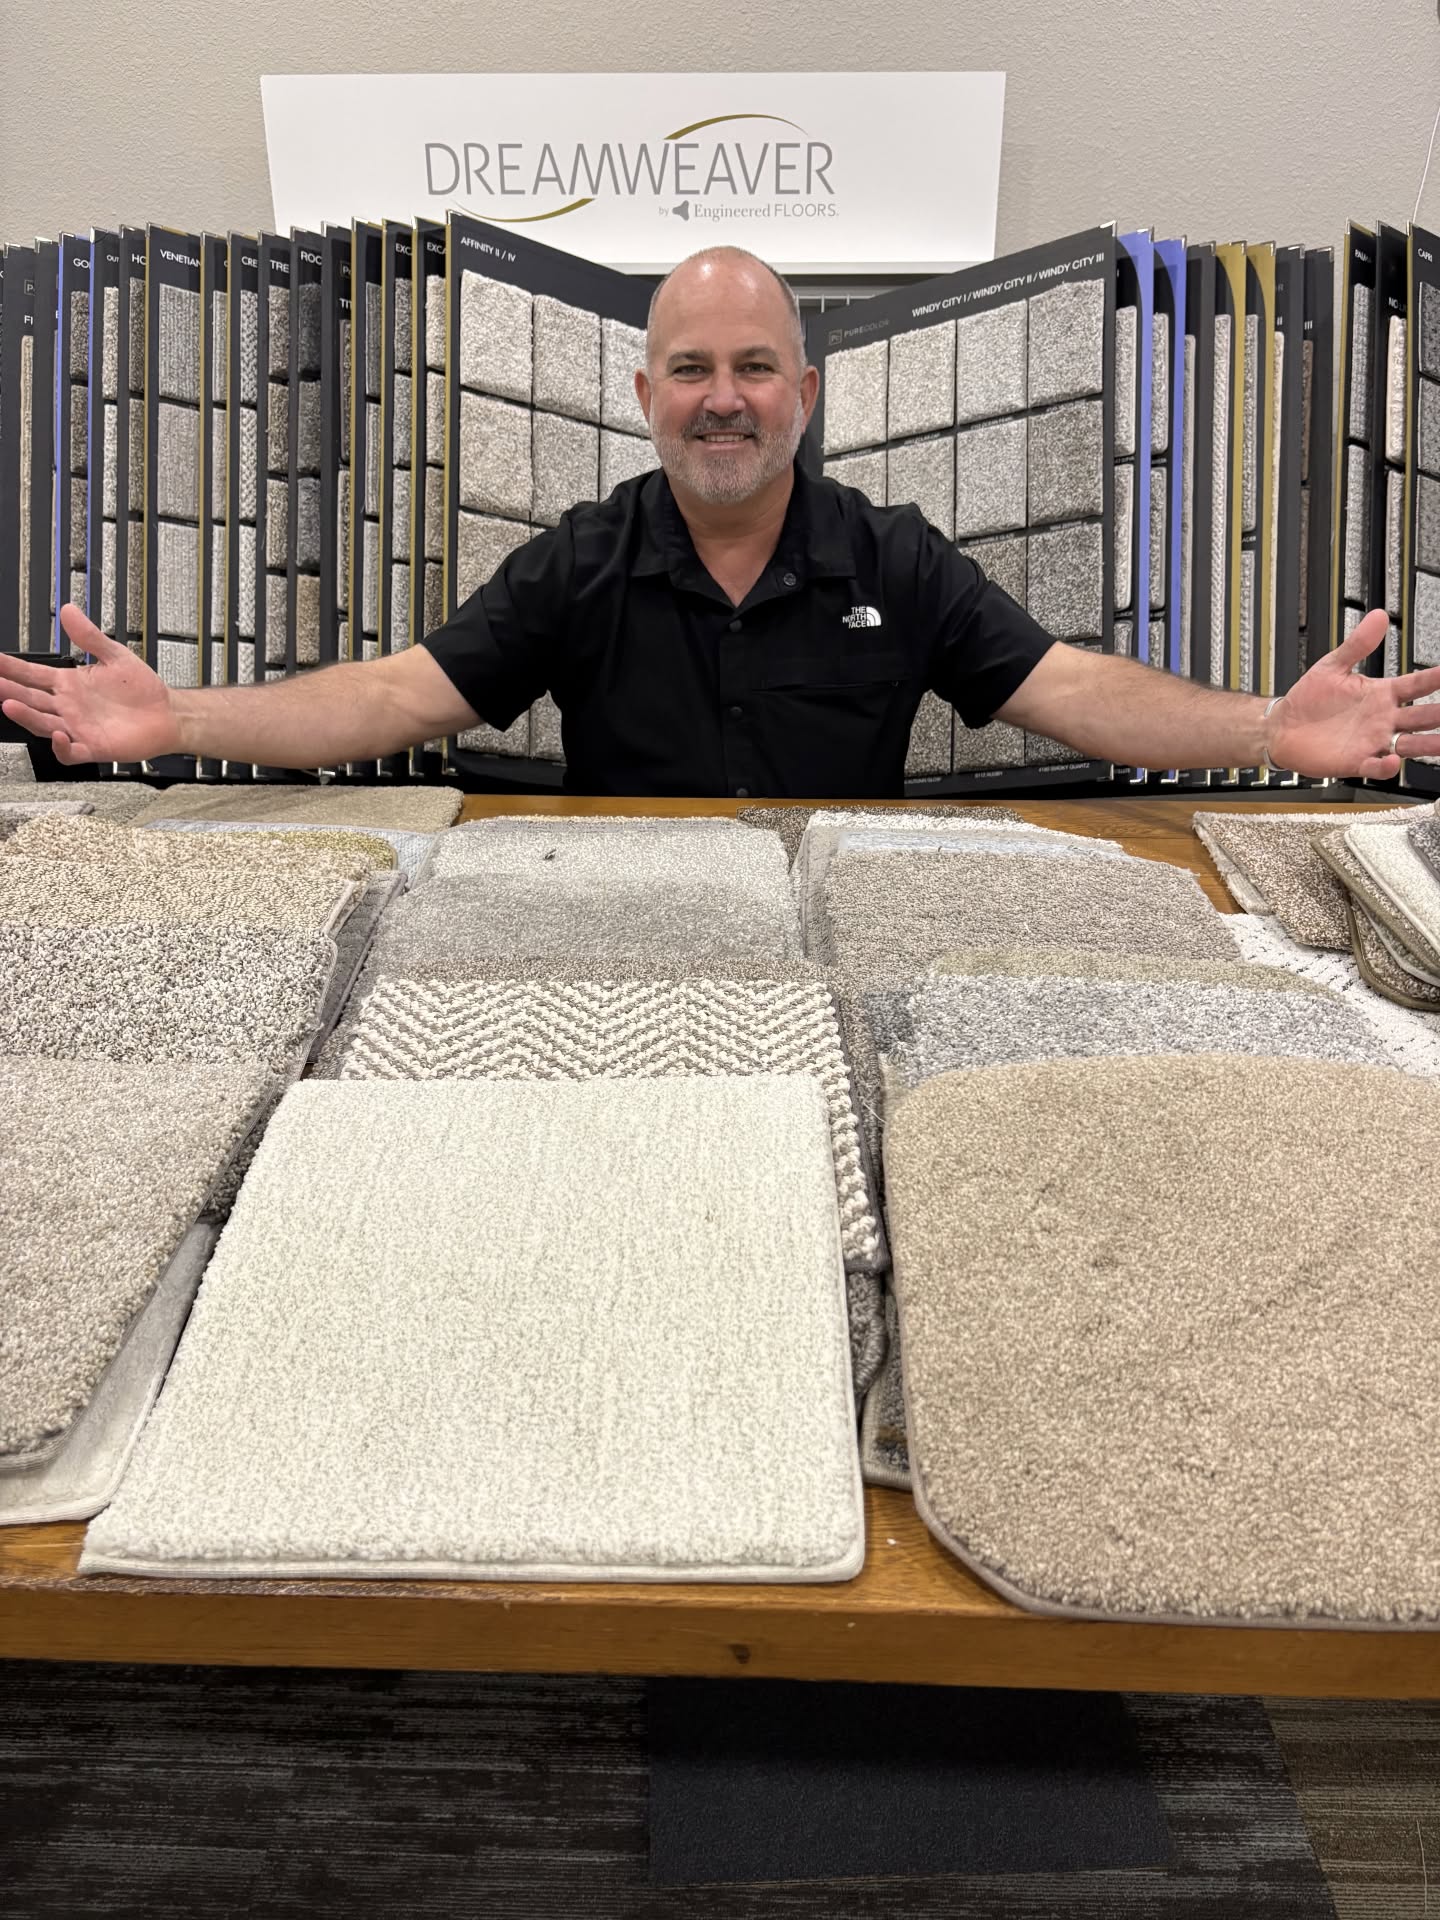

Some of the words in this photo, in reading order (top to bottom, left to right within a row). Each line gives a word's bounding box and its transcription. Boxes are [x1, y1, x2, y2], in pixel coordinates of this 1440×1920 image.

[424, 142, 836, 196] DREAMWEAVER
[658, 206, 670, 217] by
[694, 204, 770, 222] Engineered
[461, 236, 495, 256] AFFINITY
[507, 251, 517, 263] IV
[1417, 248, 1433, 262] CAPRI
[911, 301, 942, 317] WINDY
[942, 294, 963, 309] CITY
[972, 282, 1004, 299] WINDY
[1004, 275, 1026, 292] CITY
[1026, 273, 1032, 284] II
[1038, 262, 1073, 280] WINDY
[1072, 255, 1095, 271] CITY
[1096, 252, 1105, 263] III
[842, 613, 867, 623] NORTH
[850, 606, 866, 614] THE
[848, 621, 867, 629] FACE
